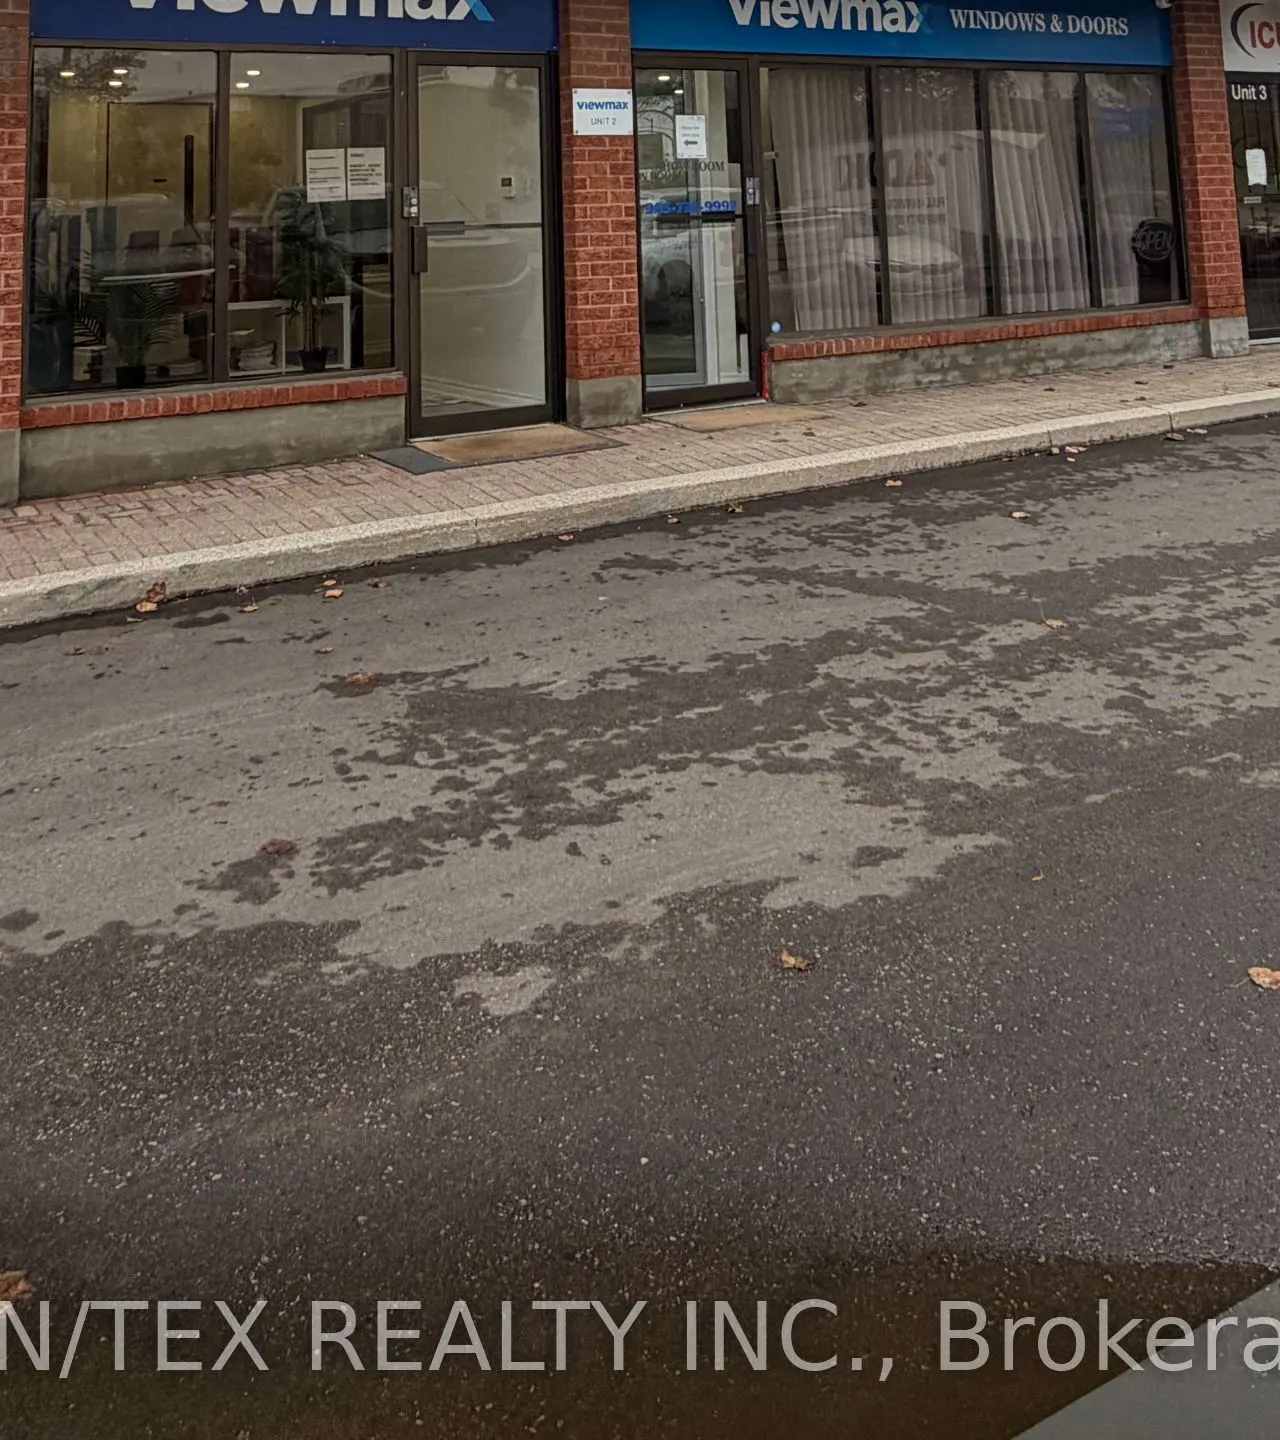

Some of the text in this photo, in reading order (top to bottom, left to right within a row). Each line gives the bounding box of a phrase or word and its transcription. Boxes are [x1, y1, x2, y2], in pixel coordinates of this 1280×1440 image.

[949, 8, 1046, 32] WINDOWS
[1050, 16, 1063, 33] &
[1067, 14, 1129, 37] DOORS
[1231, 84, 1267, 101] Unit 3
[577, 100, 629, 110] viewmax
[591, 117, 617, 126] UNIT 2
